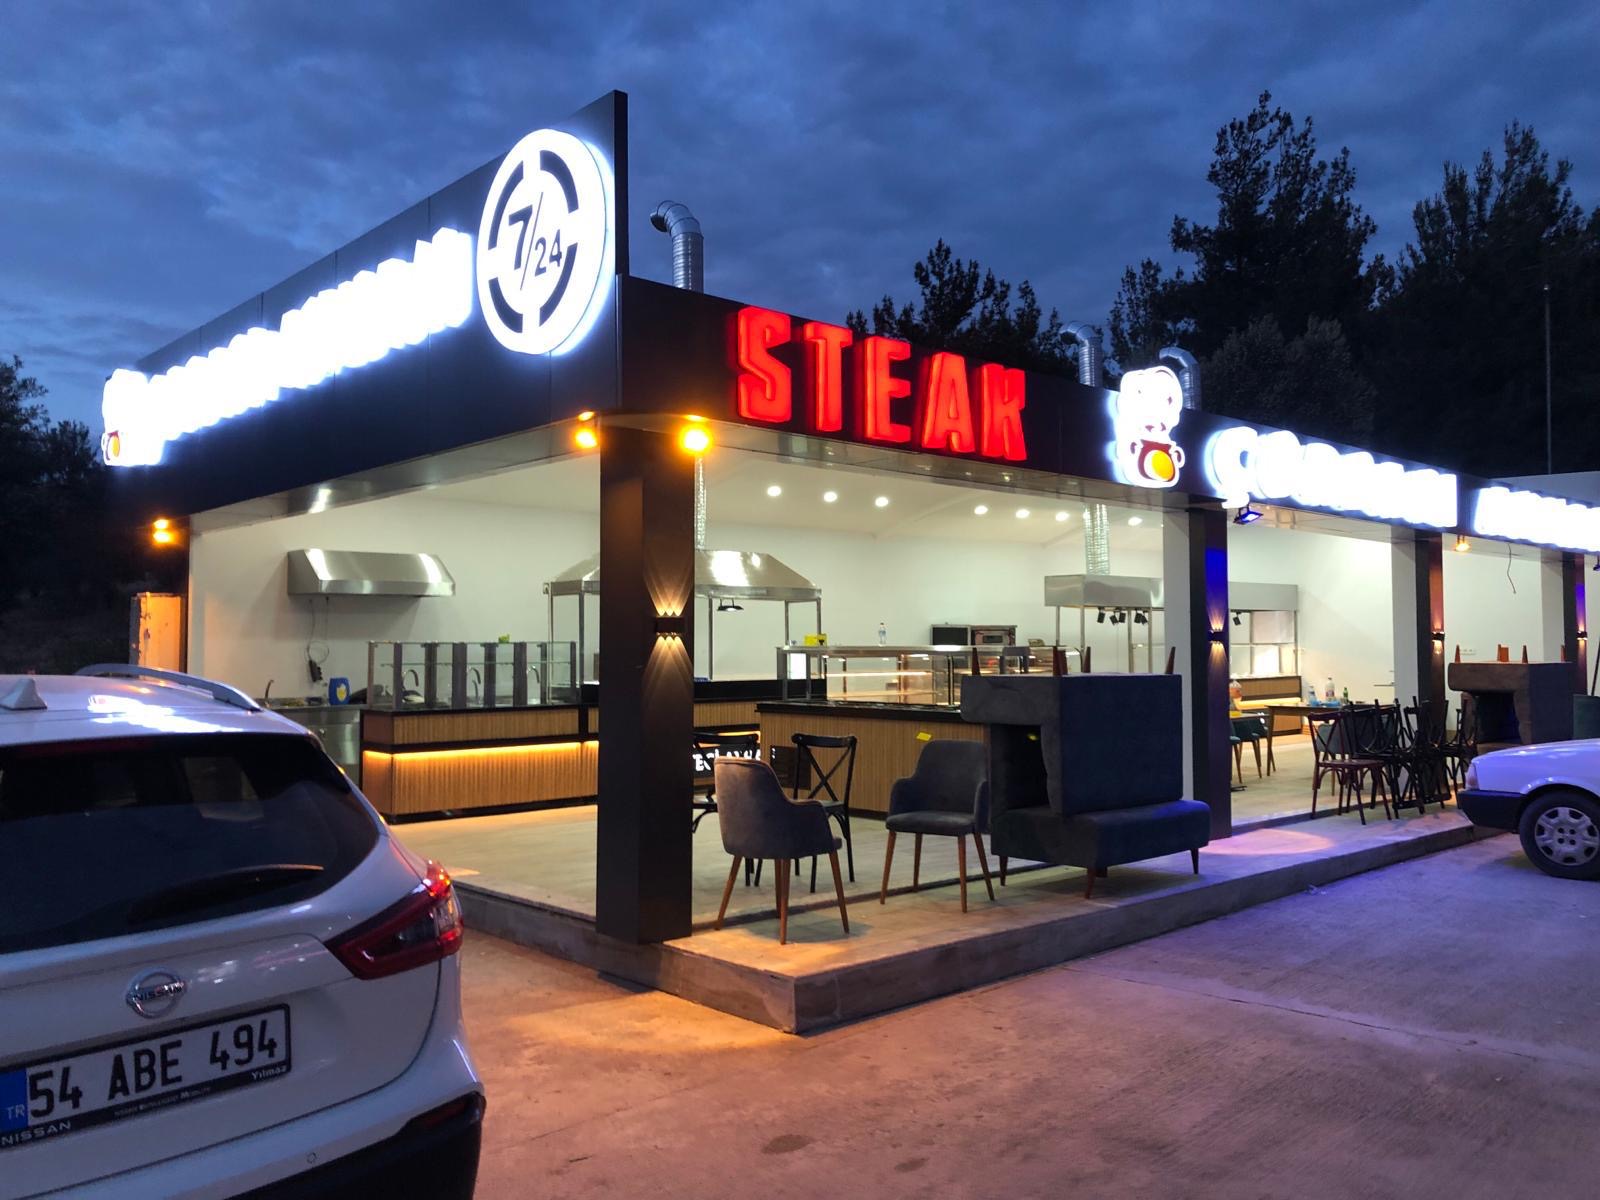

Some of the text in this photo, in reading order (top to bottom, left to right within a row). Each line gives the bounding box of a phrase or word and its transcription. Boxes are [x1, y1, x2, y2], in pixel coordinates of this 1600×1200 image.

[508, 192, 562, 291] 7/24
[737, 306, 1027, 460] STEAK
[133, 982, 184, 1001] NISSAN
[29, 1066, 83, 1118] 54
[108, 1040, 182, 1100] ABE
[210, 1020, 277, 1070] 494
[1, 1120, 71, 1145] NISSAN
[7, 1104, 25, 1120] TR
